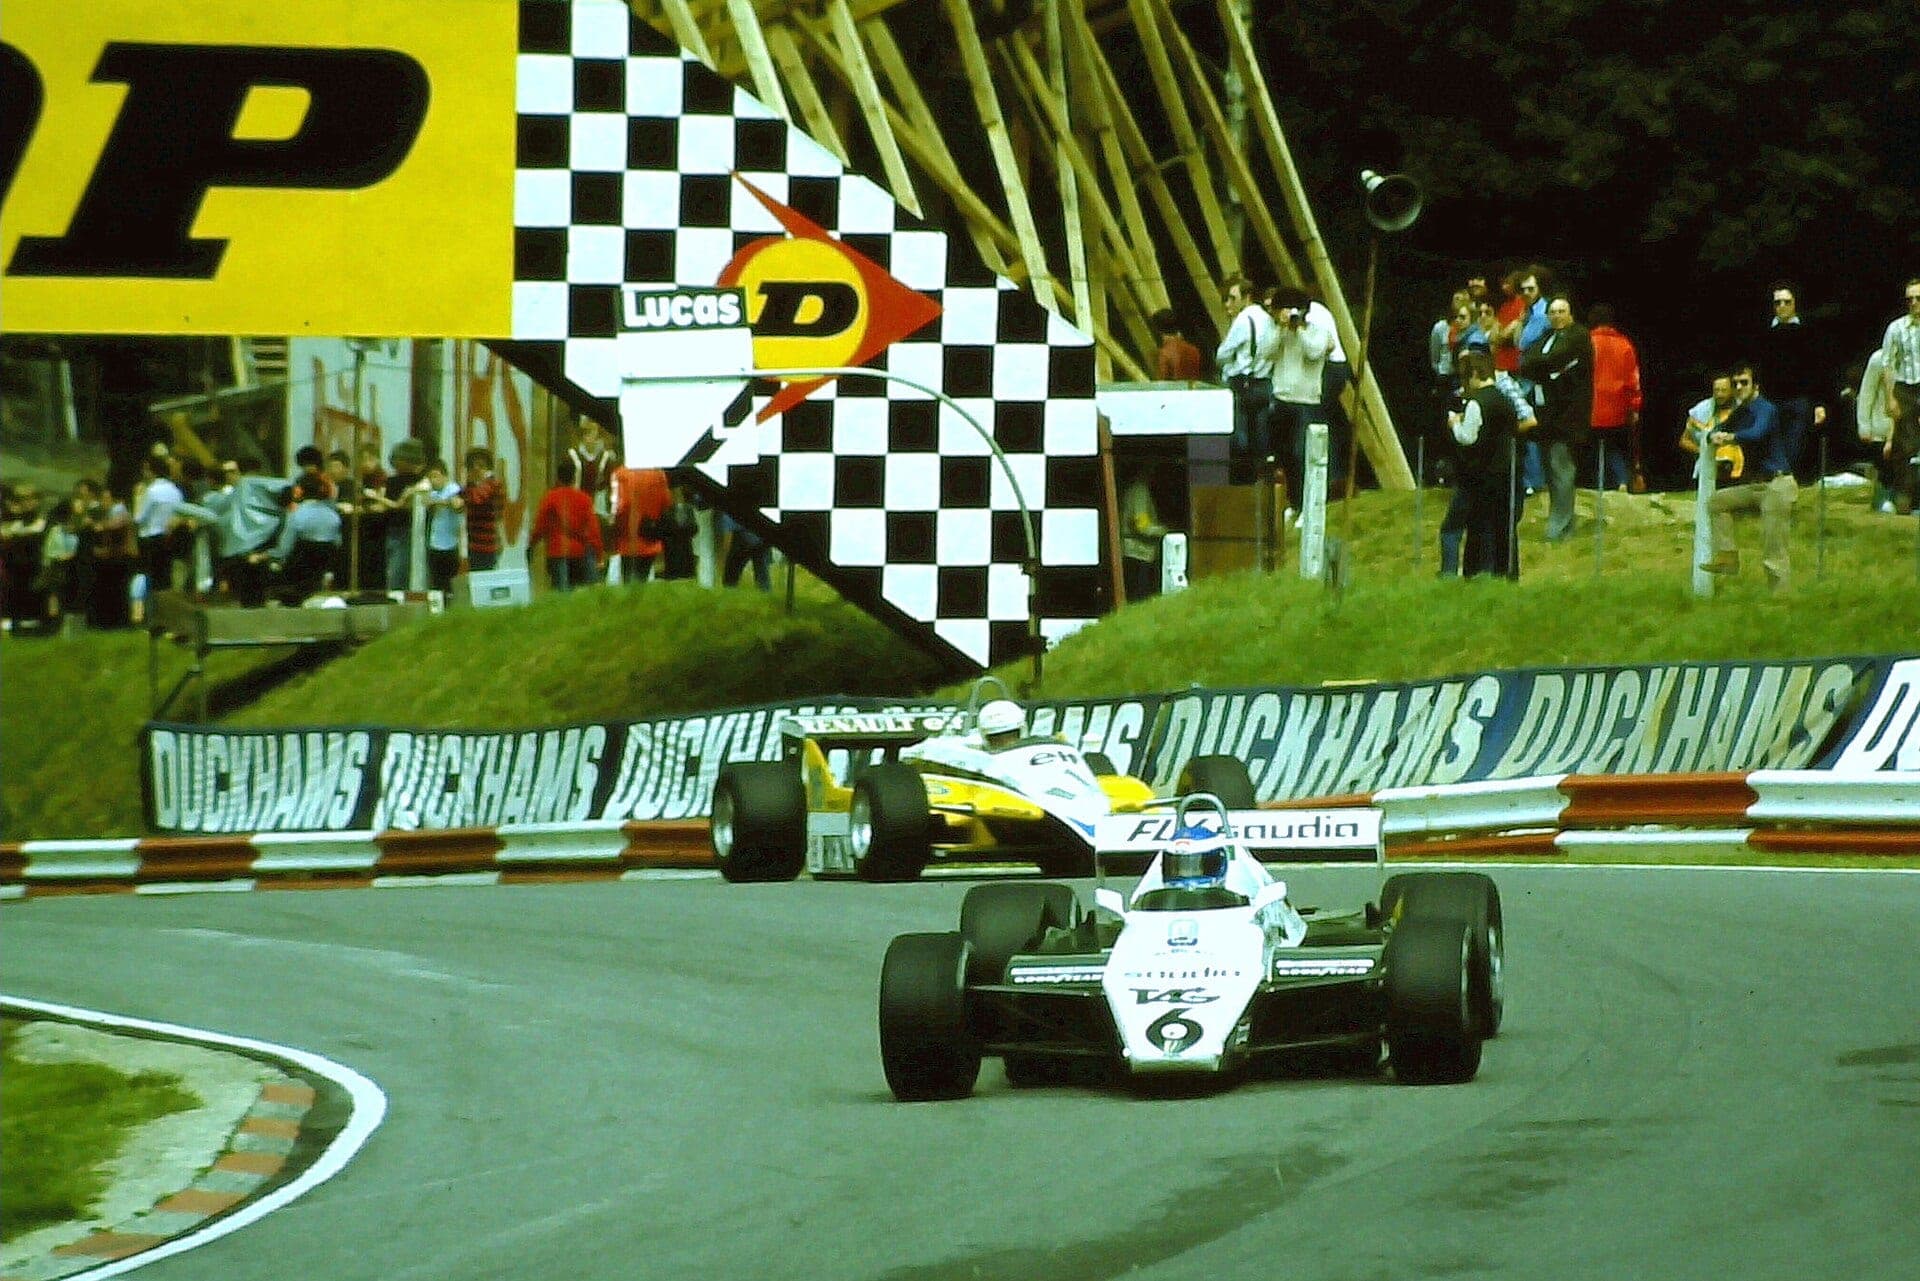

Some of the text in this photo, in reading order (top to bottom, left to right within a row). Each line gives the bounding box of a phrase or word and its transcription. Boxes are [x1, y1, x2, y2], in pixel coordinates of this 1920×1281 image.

[0, 40, 432, 281] P
[750, 281, 861, 338] D
[1150, 676, 1500, 805] DUCKHAMS
[1487, 662, 1855, 778] DUCKHAMS
[1830, 657, 1920, 772] D
[151, 730, 371, 833] DUCKHAMS
[372, 724, 608, 832] DUCKHAMS
[1127, 816, 1210, 842] FL
[1146, 1008, 1204, 1054] 6
